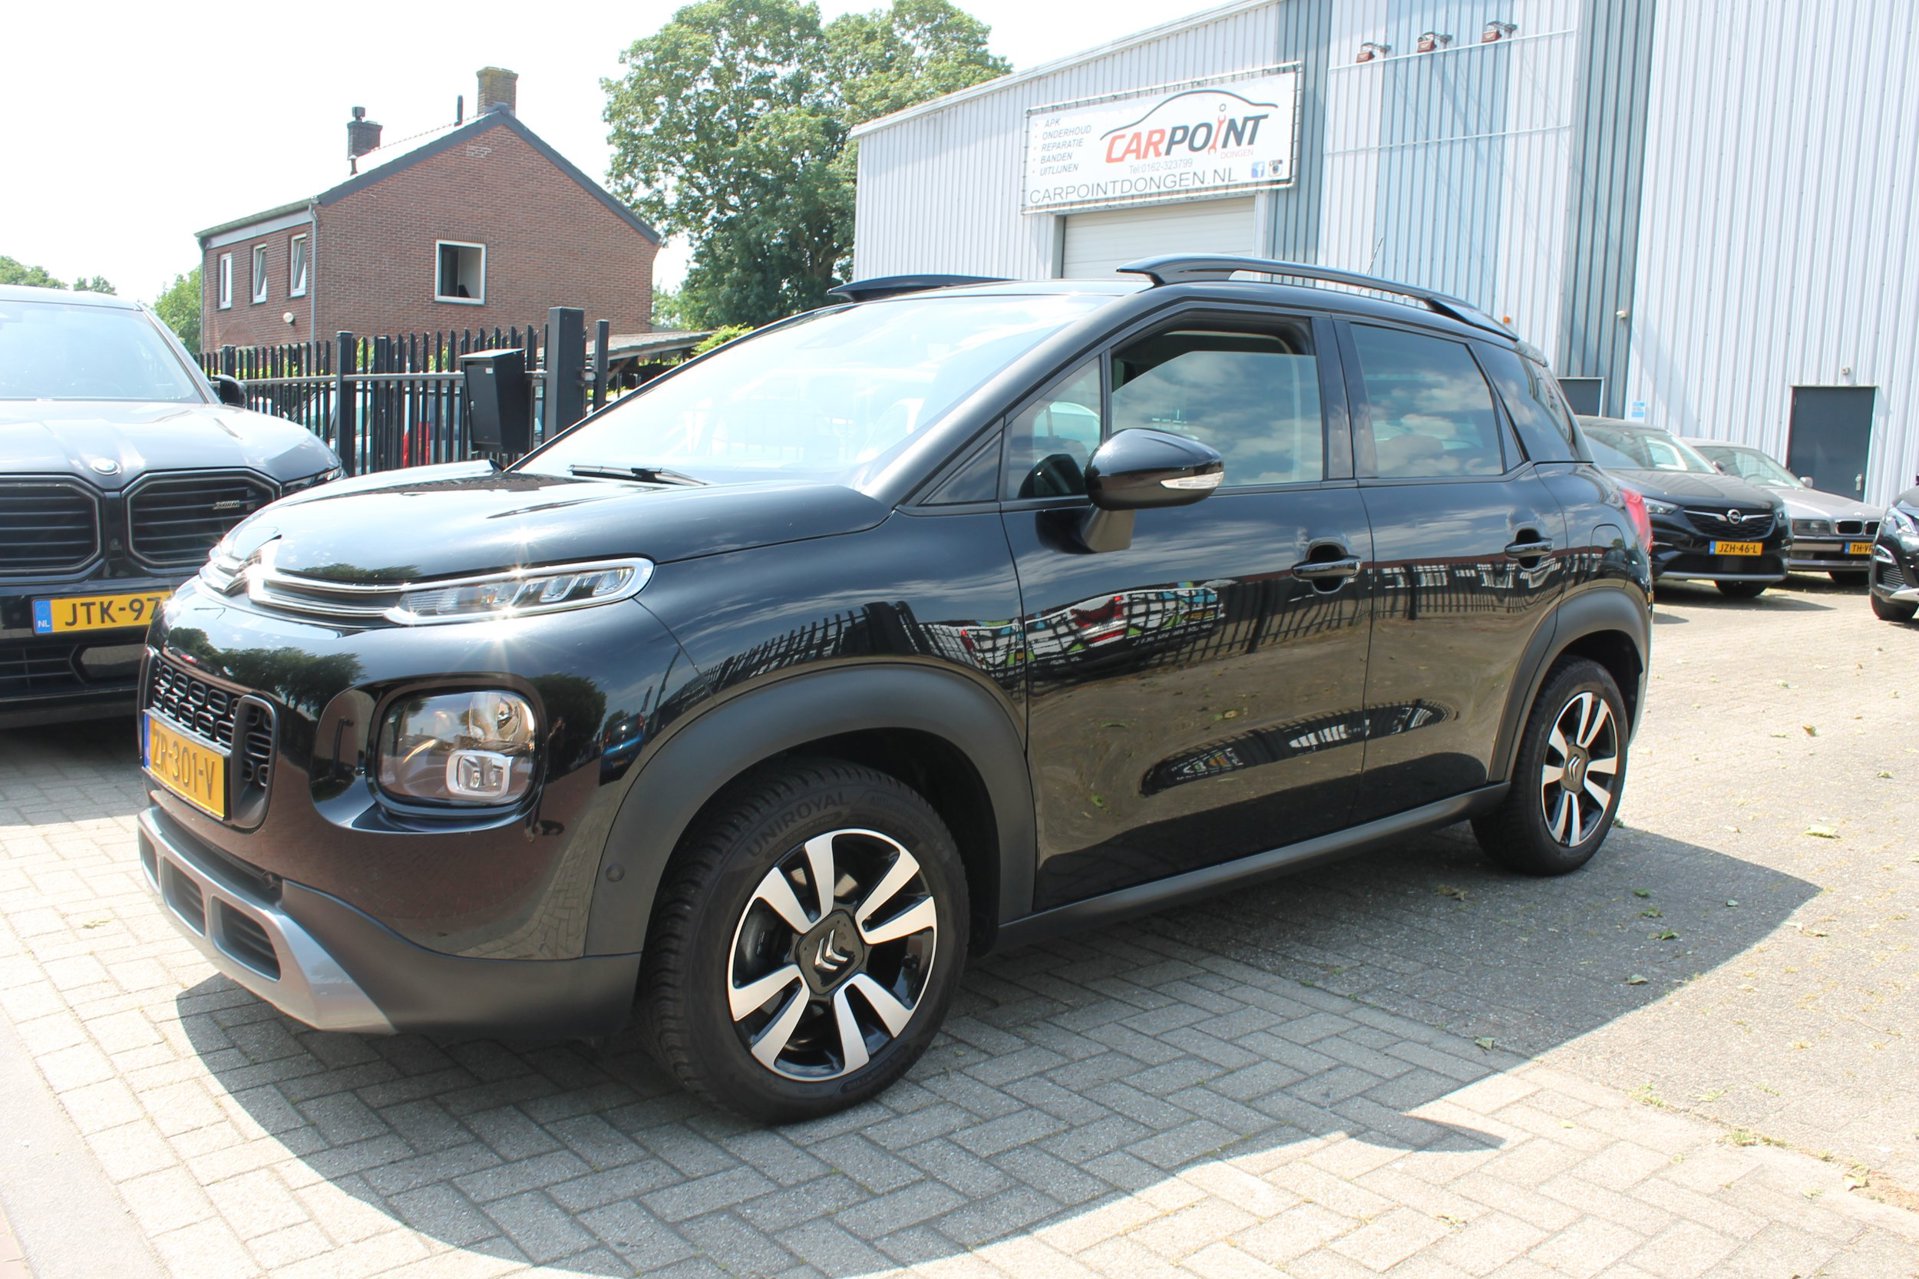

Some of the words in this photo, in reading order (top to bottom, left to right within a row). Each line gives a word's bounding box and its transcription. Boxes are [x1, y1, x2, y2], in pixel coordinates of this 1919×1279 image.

[1044, 118, 1061, 128] APK
[1042, 125, 1092, 140] ONDERHOUD
[1105, 108, 1269, 163] CARPOINT
[1041, 138, 1084, 152] REPARATIE
[1040, 152, 1073, 164] BANDEN
[1220, 149, 1254, 160] DONGEN
[1040, 163, 1079, 176] UITLIJNEN
[1030, 167, 1238, 204] CARPOINTDONGEN.NL
[1719, 543, 1757, 553] JZH-46-L
[38, 620, 50, 628] NL
[746, 791, 849, 856] UNIROYAL
